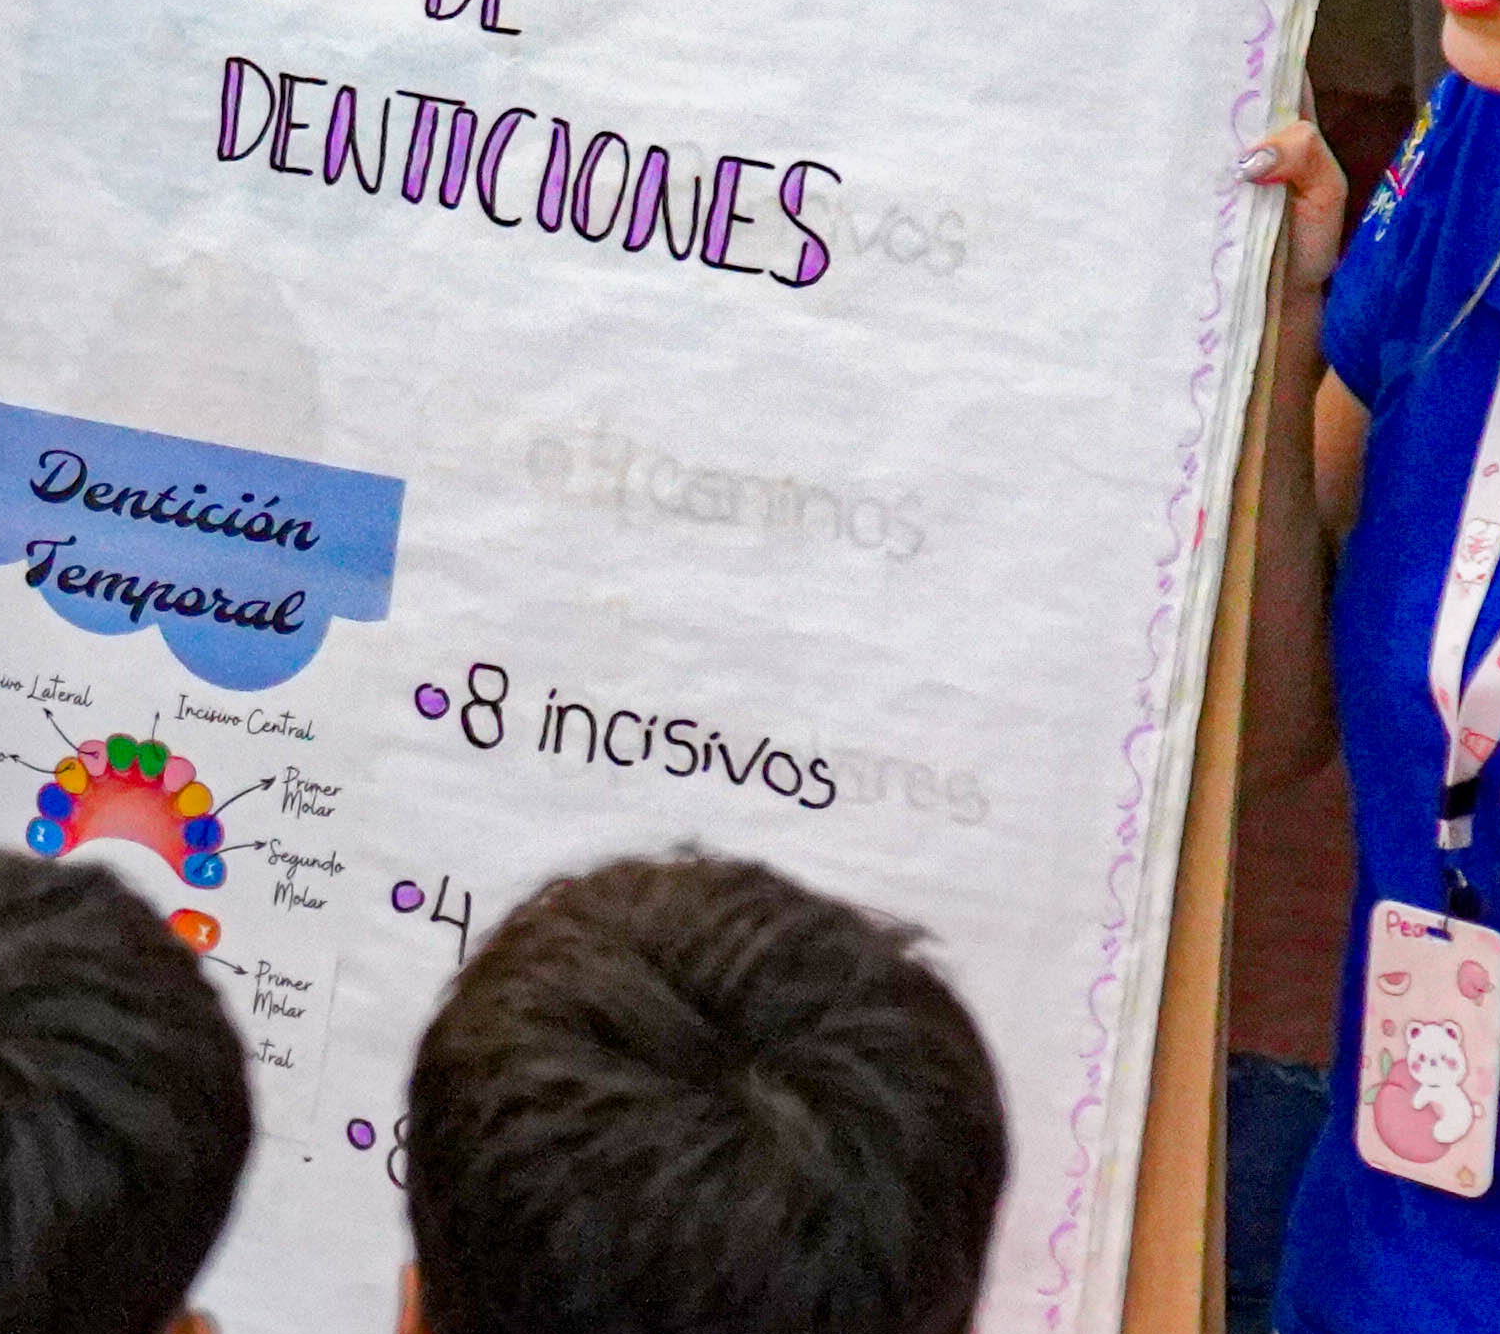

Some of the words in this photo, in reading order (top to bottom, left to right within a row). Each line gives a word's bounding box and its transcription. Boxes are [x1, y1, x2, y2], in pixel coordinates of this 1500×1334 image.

[216, 57, 842, 287] DENTICIONES
[30, 449, 320, 551] Dentición
[25, 535, 307, 635] Temporal
[28, 674, 93, 708] Lateral
[175, 694, 242, 727] Incisivo
[246, 709, 316, 741] Central
[461, 663, 508, 749] 8
[538, 688, 838, 809] incisivos
[283, 766, 343, 797] Primer
[281, 789, 336, 819] Molar
[267, 838, 346, 879] Segundo
[274, 881, 328, 911] Molar
[430, 874, 471, 966] 4
[255, 960, 314, 992] Primer
[252, 990, 306, 1020] Molar
